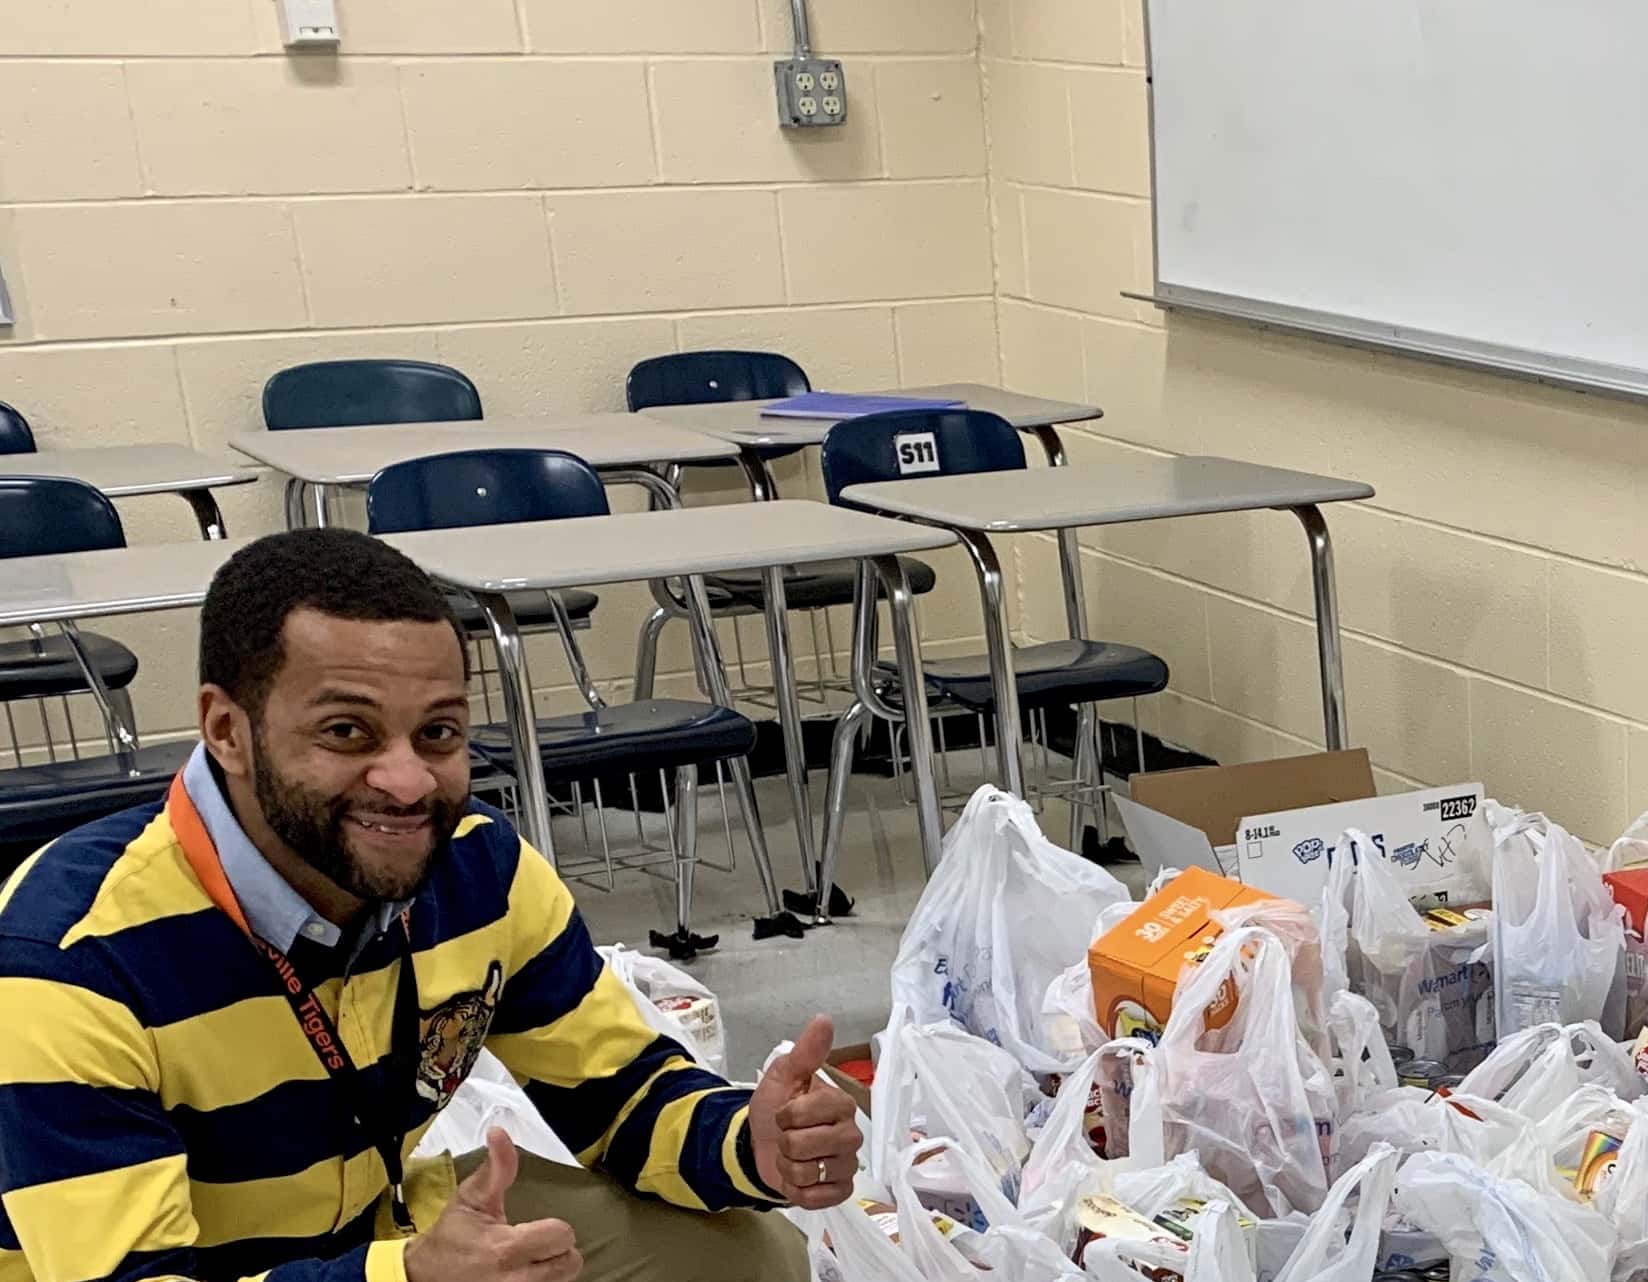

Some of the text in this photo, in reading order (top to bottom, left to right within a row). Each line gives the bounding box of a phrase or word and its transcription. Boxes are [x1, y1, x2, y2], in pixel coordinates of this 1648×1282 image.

[900, 440, 934, 465] S11
[1441, 797, 1476, 819] 22362
[1417, 965, 1469, 995] Wamart
[262, 942, 345, 1070] ville Tigers
